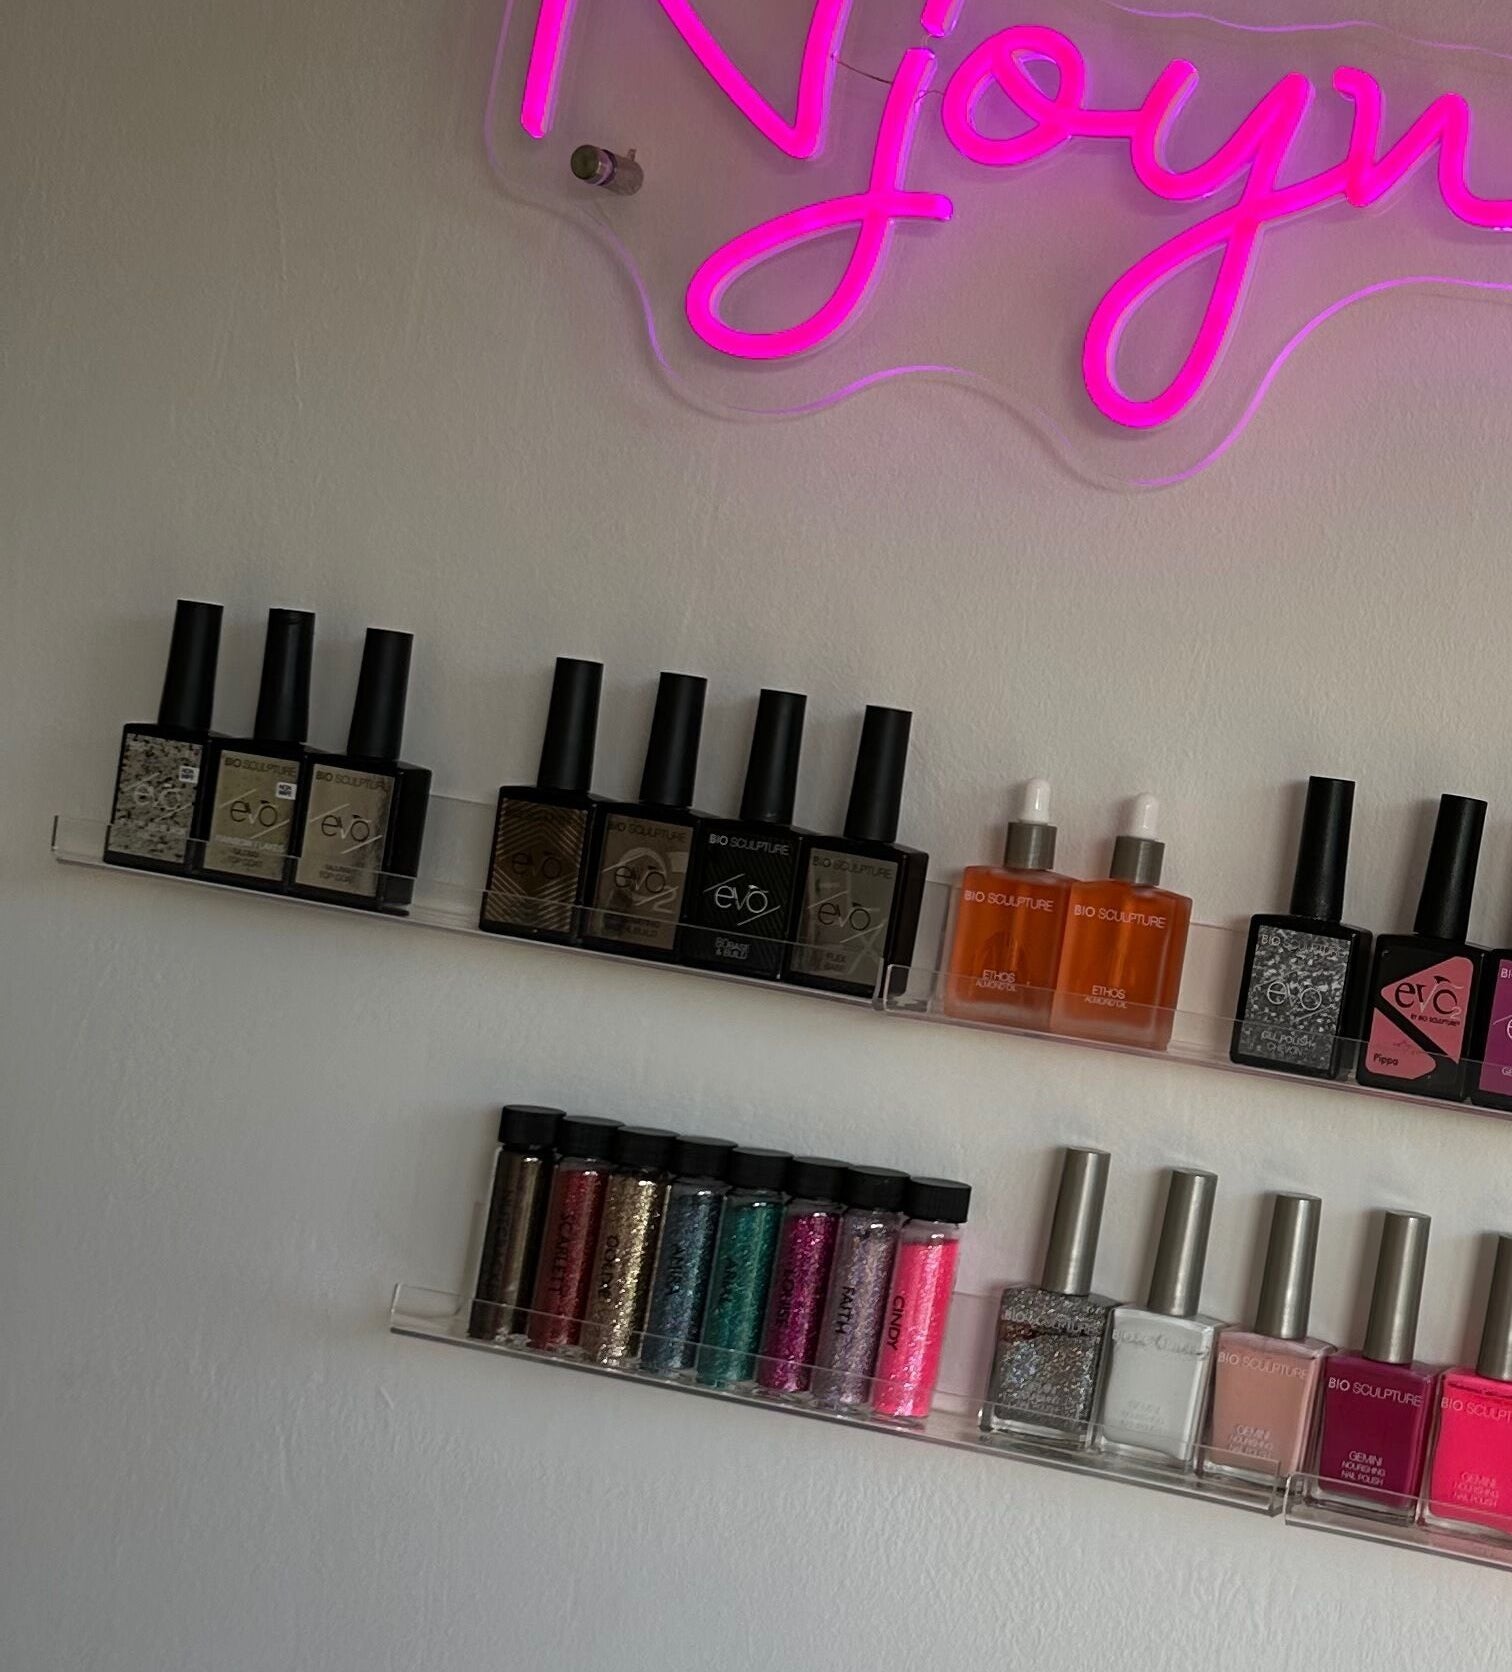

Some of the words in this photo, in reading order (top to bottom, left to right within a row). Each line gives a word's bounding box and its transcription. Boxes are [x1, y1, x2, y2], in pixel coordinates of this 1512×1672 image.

[628, 823, 687, 842] SCULPTURE
[709, 833, 728, 846] BIO
[730, 837, 790, 856] SCULPTURE
[833, 860, 894, 880] SCULPTURE
[964, 889, 985, 903] BIO
[987, 892, 1054, 912] SCULPTURE
[1074, 904, 1095, 918] BIO
[1098, 907, 1167, 929] SCULPTURE
[1261, 934, 1280, 946] BIO
[983, 969, 1016, 984] ETHOS
[1092, 984, 1126, 1000] ETHOS
[1373, 1053, 1399, 1066] Pippa
[834, 1286, 856, 1334] FAITH
[885, 1295, 906, 1351] CINDY
[1218, 1352, 1240, 1366] BIO
[1242, 1356, 1308, 1379] SCULPTURE
[1328, 1376, 1351, 1391] BIO
[1352, 1382, 1424, 1407] SCULPTURE
[1441, 1396, 1464, 1411] BIO
[1348, 1450, 1383, 1467] GEMINI
